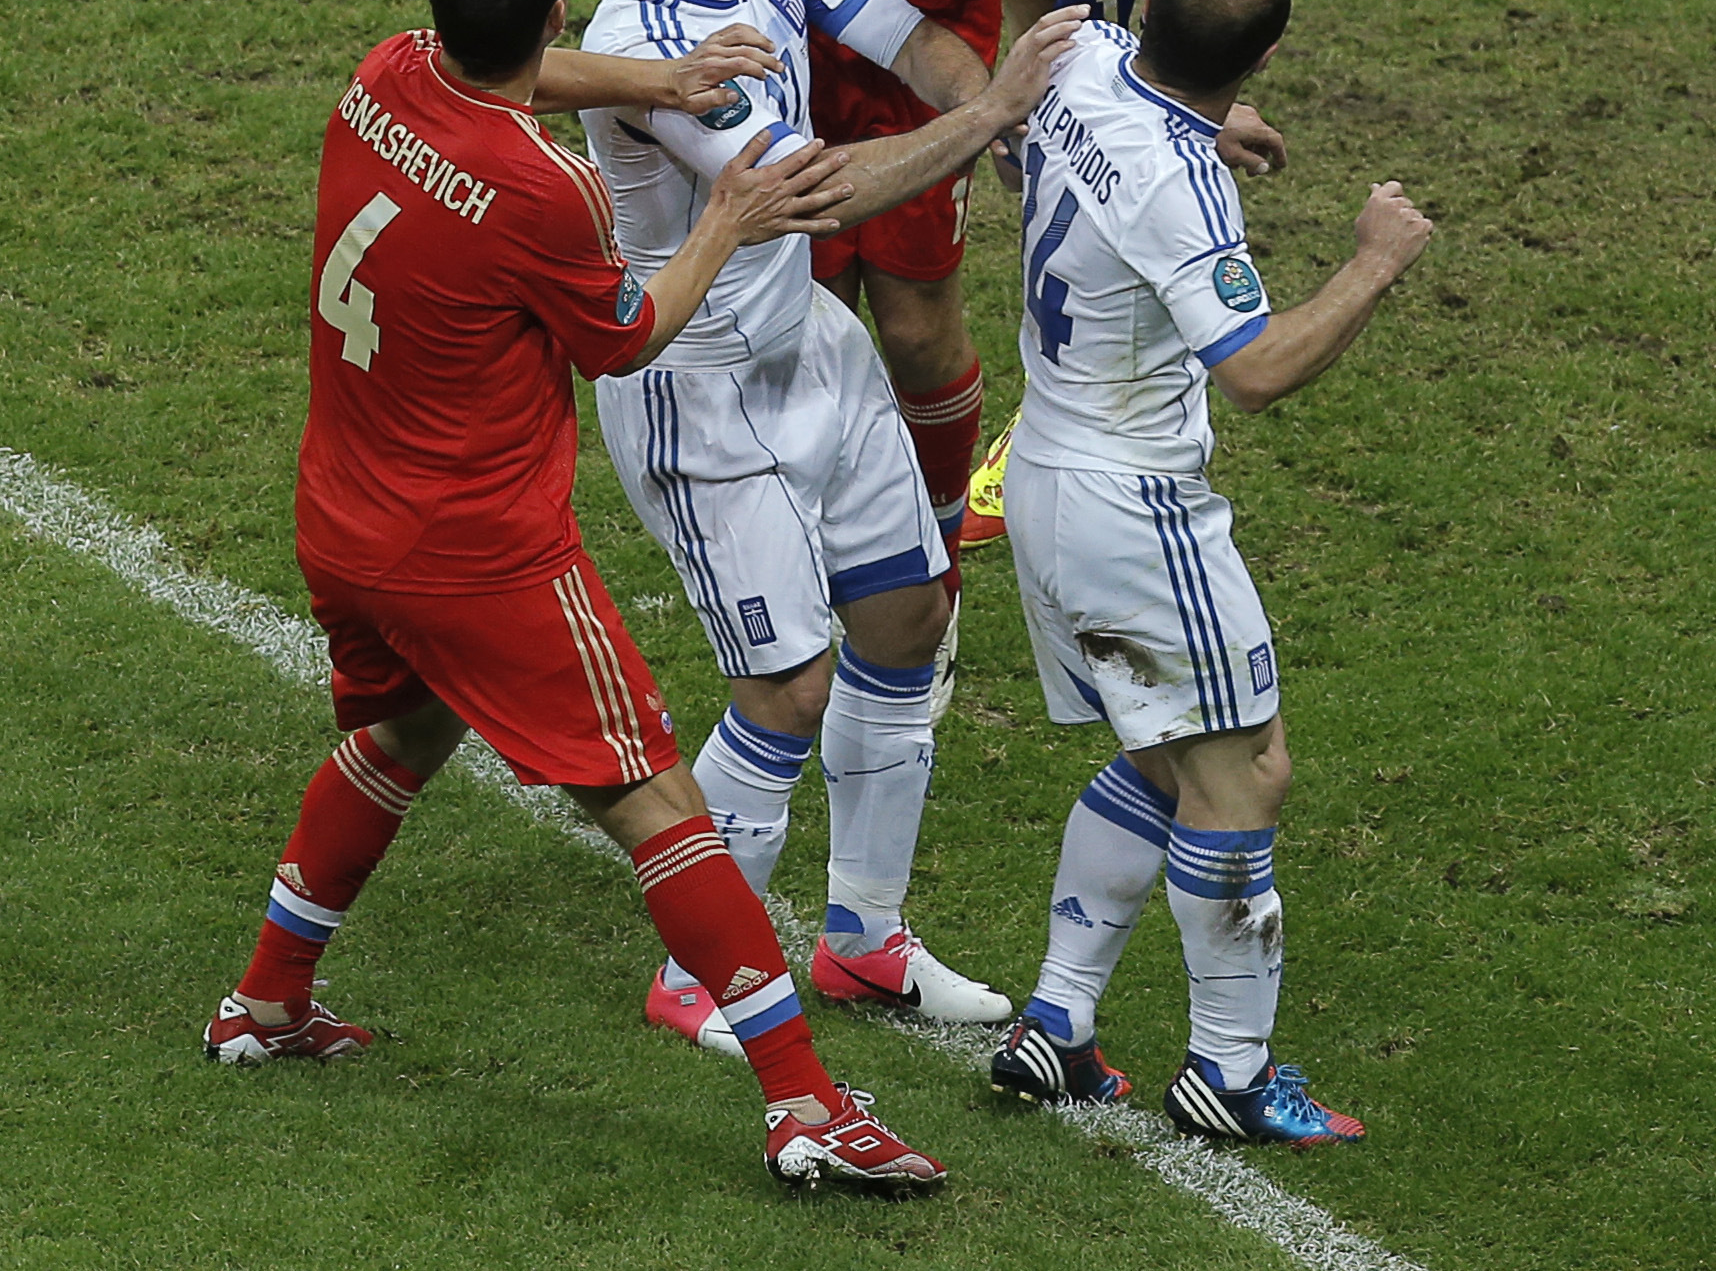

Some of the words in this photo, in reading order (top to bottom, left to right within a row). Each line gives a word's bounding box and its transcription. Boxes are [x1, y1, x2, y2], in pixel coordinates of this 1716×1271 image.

[338, 76, 497, 226] IGNASHEVICH
[317, 190, 402, 372] 4
[1022, 141, 1080, 367] 14
[722, 971, 769, 1000] adidas
